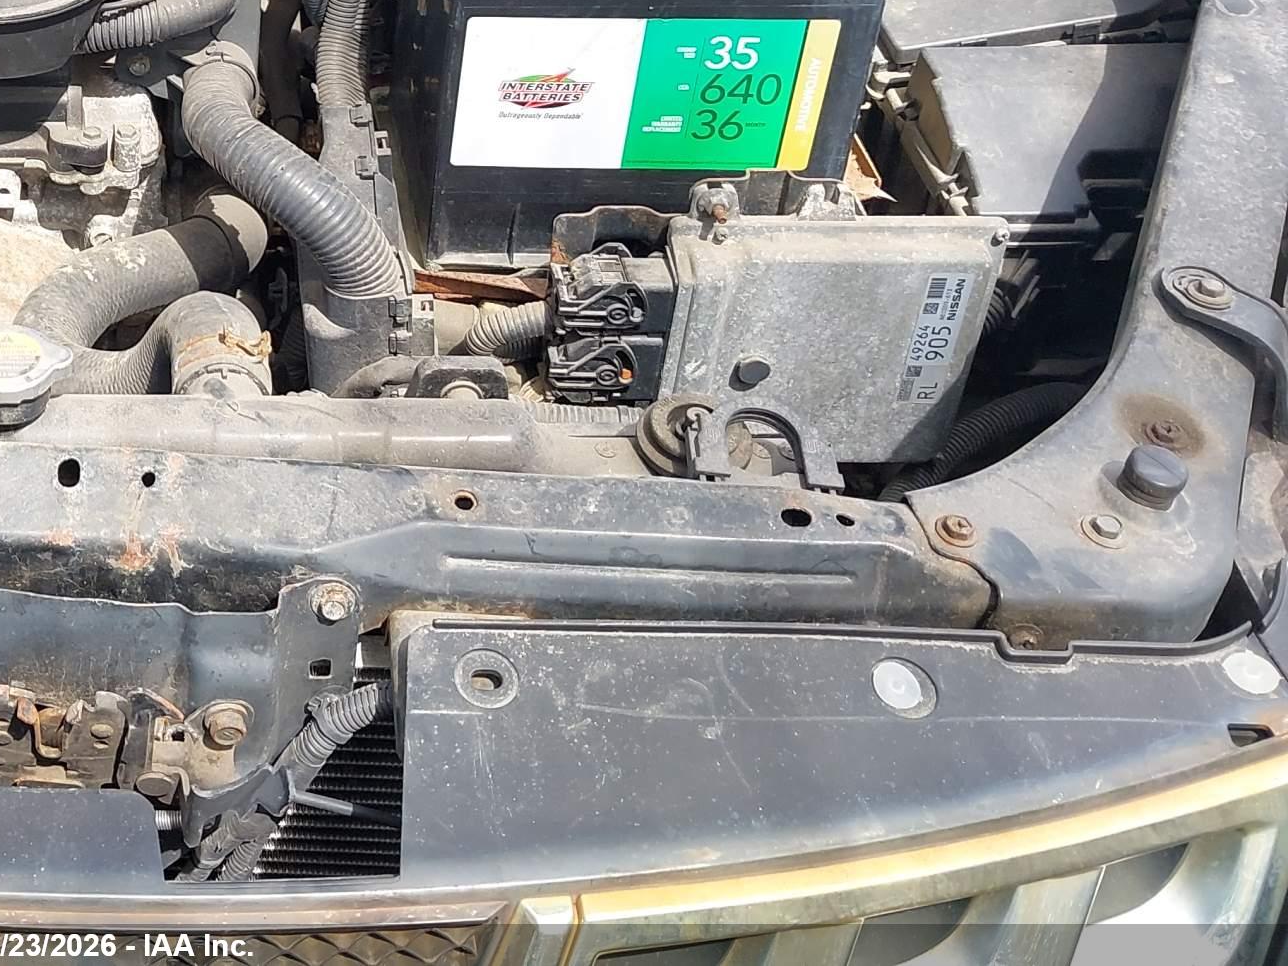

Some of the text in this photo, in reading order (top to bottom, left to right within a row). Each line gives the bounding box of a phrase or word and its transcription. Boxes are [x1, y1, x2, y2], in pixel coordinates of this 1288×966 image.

[704, 35, 760, 70] 35
[502, 82, 589, 92] INTERSTATE
[502, 93, 580, 102] BATTERIES
[700, 73, 782, 105] 640
[794, 58, 821, 131] AUTOMOTIVE
[498, 112, 541, 120] Outrageously
[691, 108, 744, 140] 36
[947, 278, 966, 320] NISSAN
[910, 325, 930, 361] 49264
[924, 326, 952, 360] 905
[917, 382, 938, 400] RL
